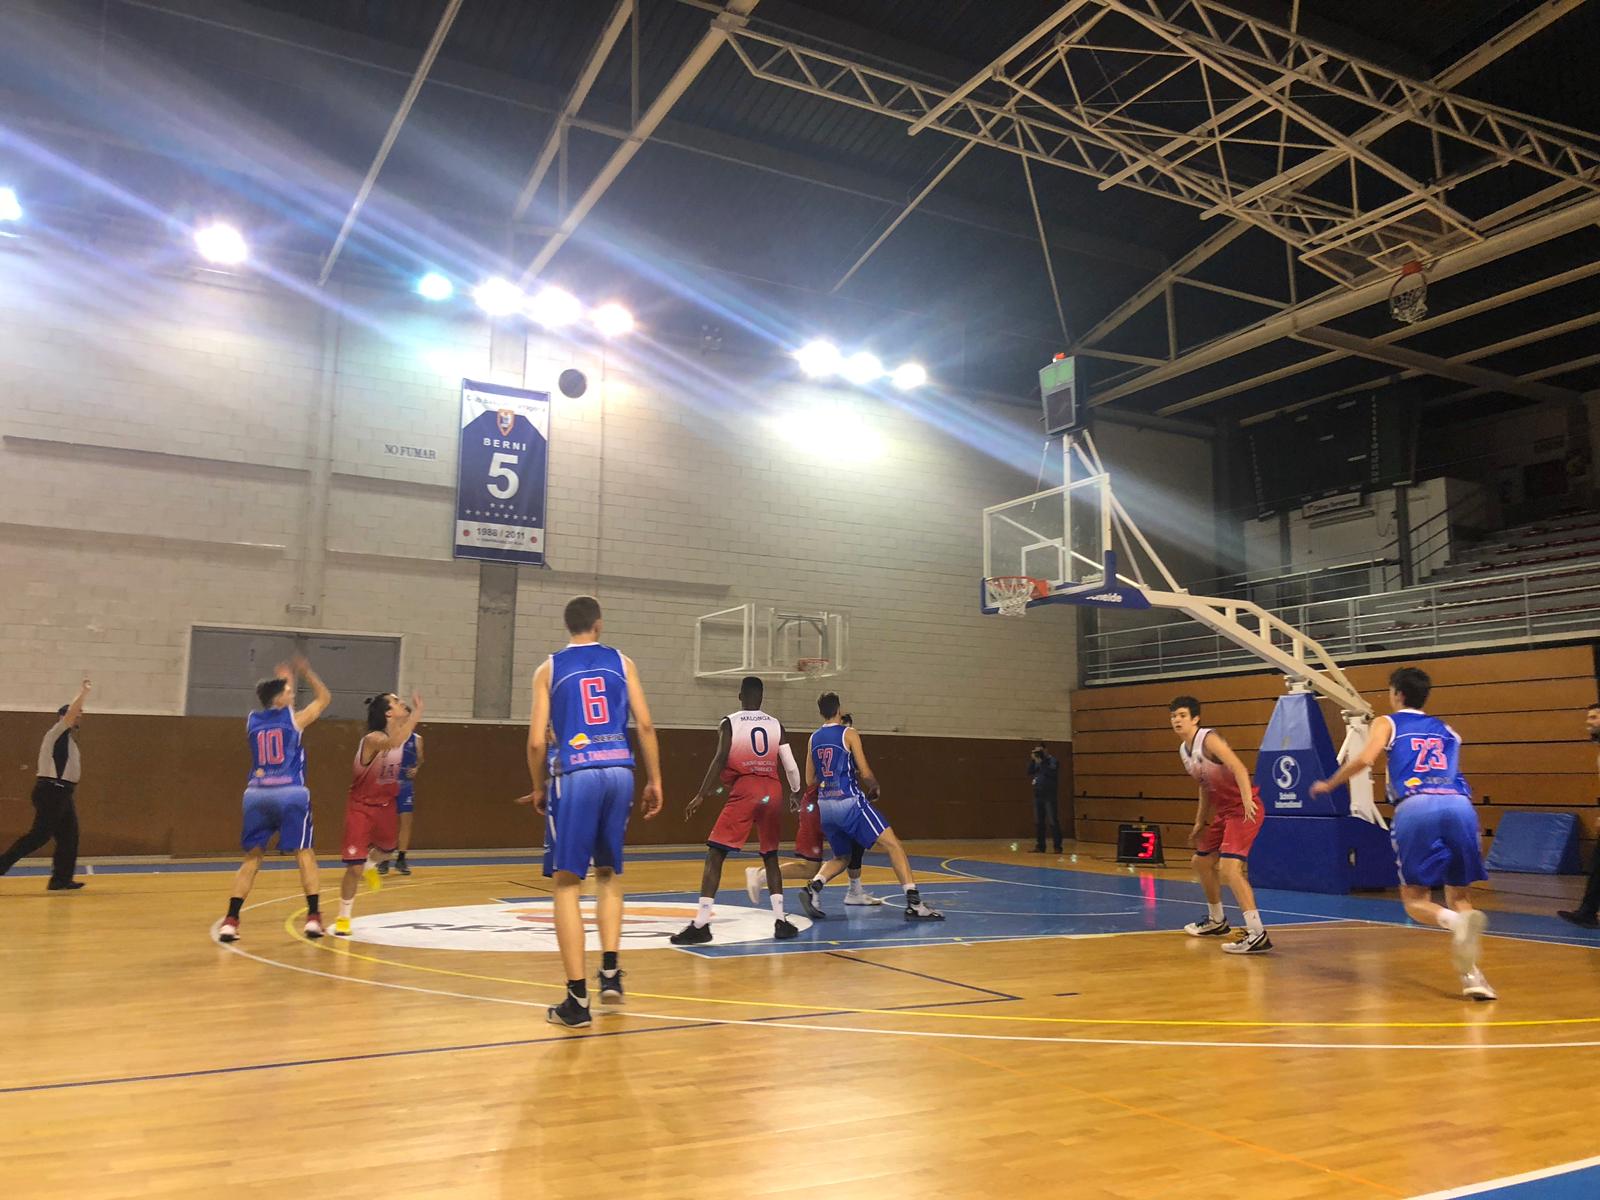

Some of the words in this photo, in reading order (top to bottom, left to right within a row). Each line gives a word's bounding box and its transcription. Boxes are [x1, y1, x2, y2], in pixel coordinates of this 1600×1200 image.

[384, 443, 400, 455] NO
[400, 446, 436, 460] FUMAR
[483, 437, 527, 451] BERNI
[486, 452, 519, 500] 5
[505, 530, 525, 540] 2011
[579, 676, 610, 725] 6
[257, 729, 285, 766] 10
[751, 727, 769, 757] 0
[1411, 738, 1448, 773] 23
[1138, 832, 1156, 859] 3
